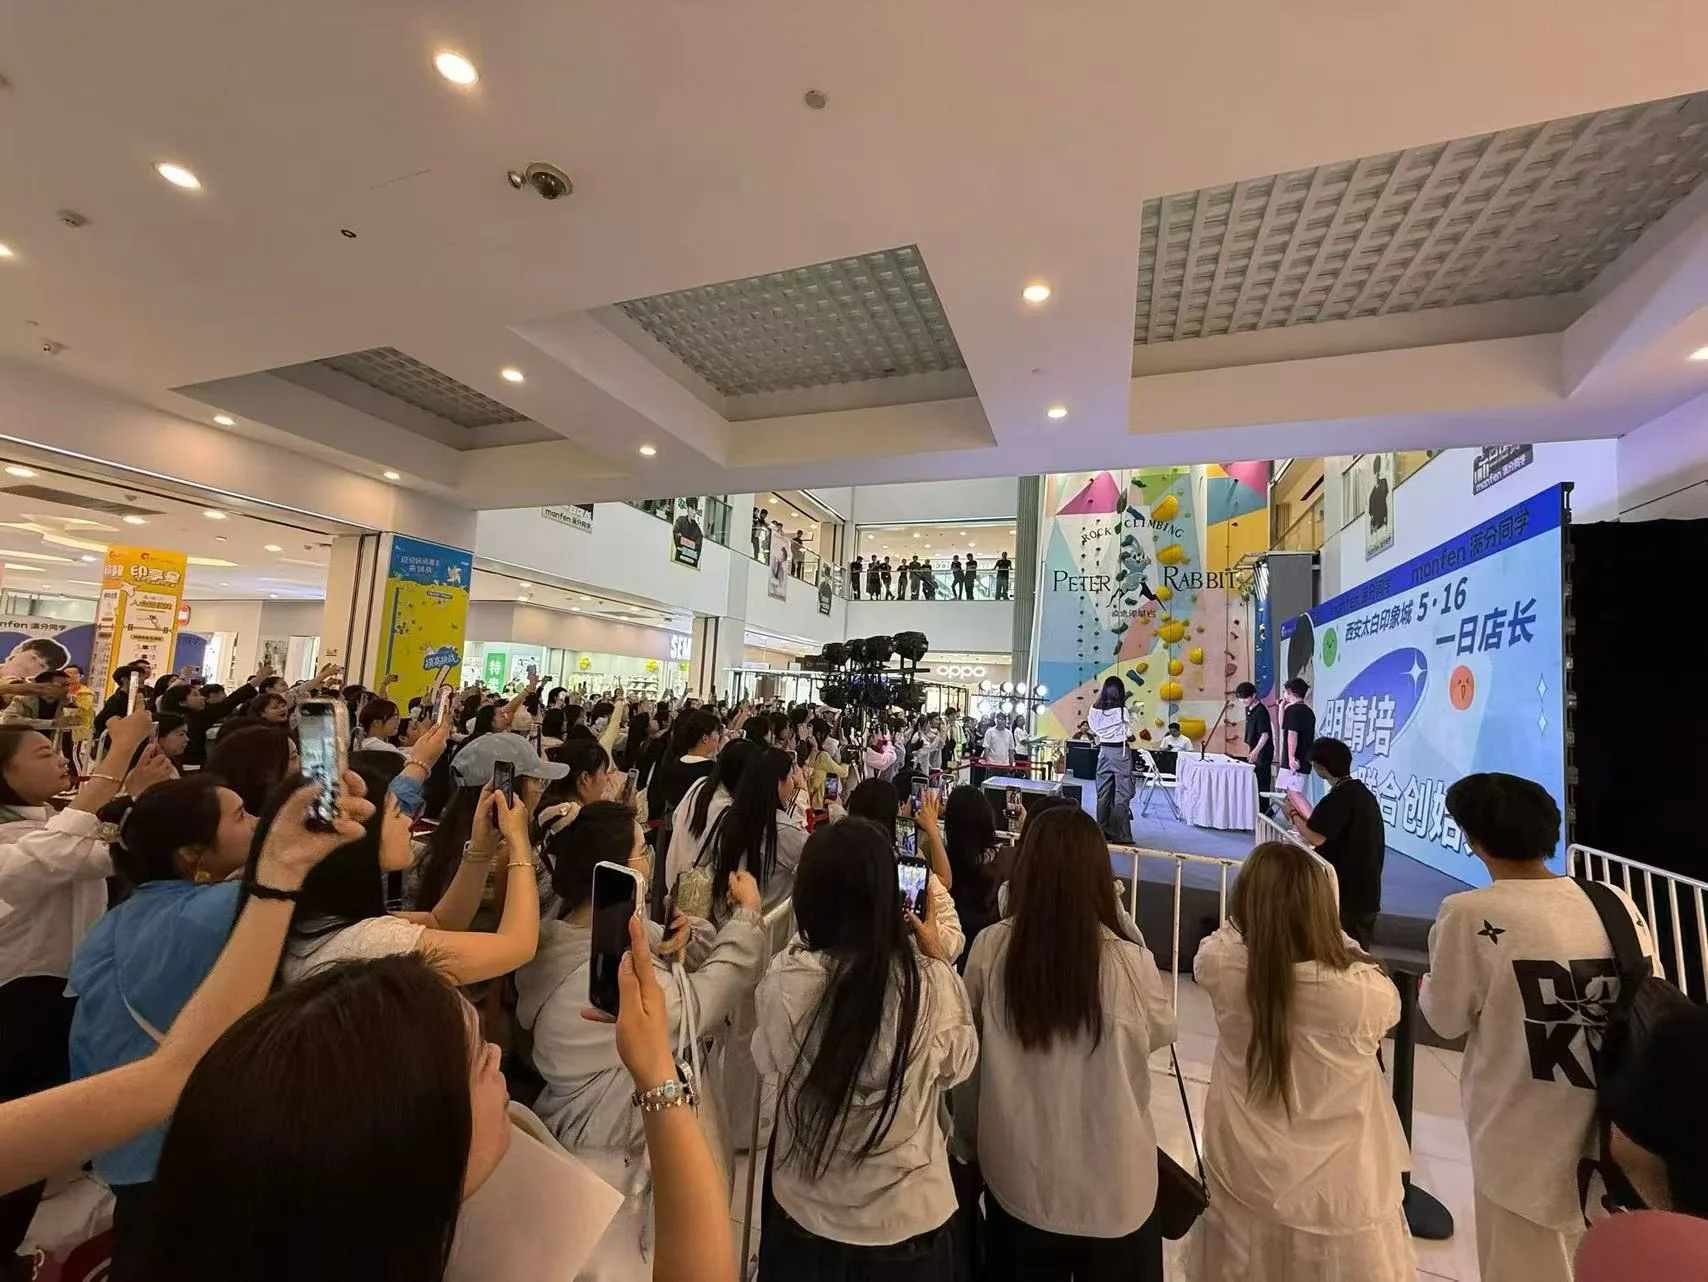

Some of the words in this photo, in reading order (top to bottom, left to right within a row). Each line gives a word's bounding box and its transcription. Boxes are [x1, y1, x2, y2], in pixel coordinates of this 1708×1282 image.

[1082, 527, 1111, 542] ROCK
[1124, 519, 1185, 538] CLIMBING
[1470, 509, 1530, 558] 满分同学
[1053, 570, 1111, 592] PETER
[1164, 565, 1238, 592] RABBIT
[1345, 599, 1413, 641] 西安太白印象城
[1435, 598, 1537, 656] 一日店长
[1352, 767, 1474, 857] 合创始
